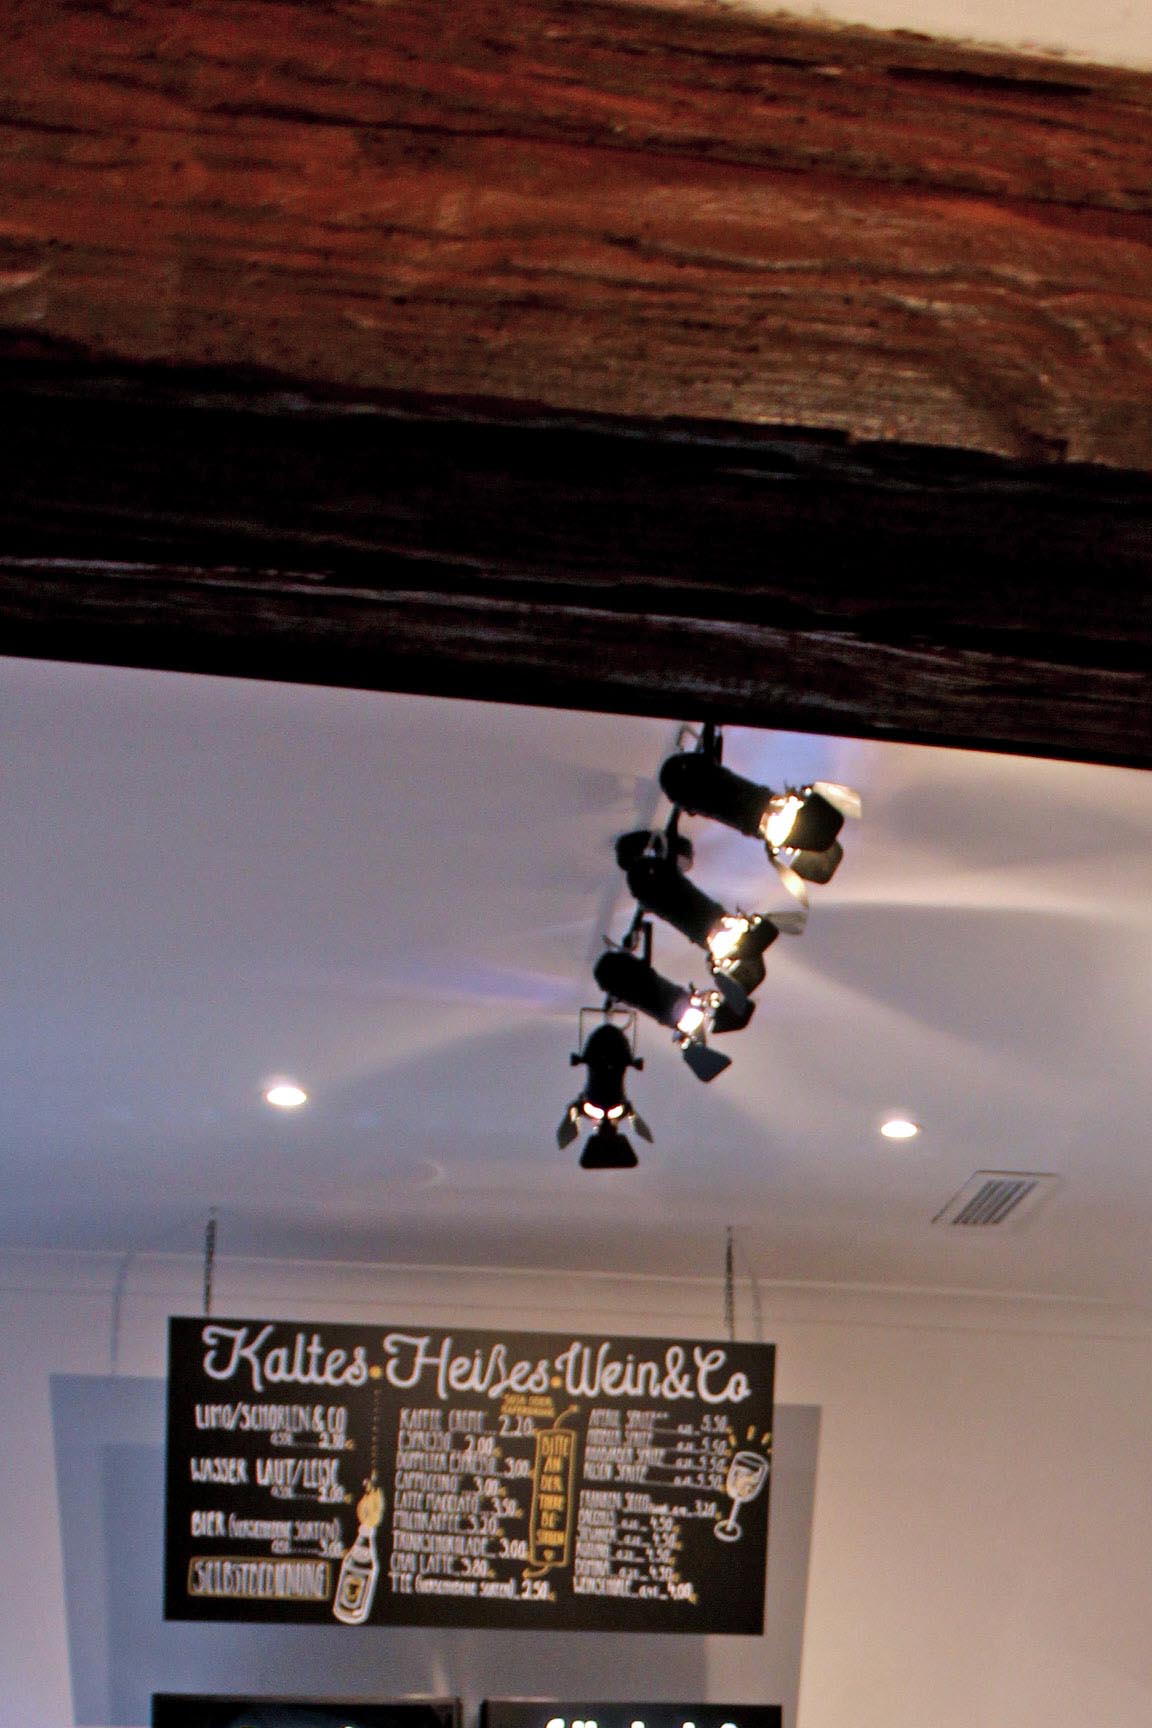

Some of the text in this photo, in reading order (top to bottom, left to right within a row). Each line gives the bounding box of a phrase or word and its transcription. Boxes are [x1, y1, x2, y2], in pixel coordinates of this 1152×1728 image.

[202, 1325, 368, 1392] Kaltes
[383, 1333, 551, 1400] Heißes
[693, 1346, 752, 1404] Co
[190, 1457, 249, 1484] WASSER
[191, 1510, 226, 1538] BIER
